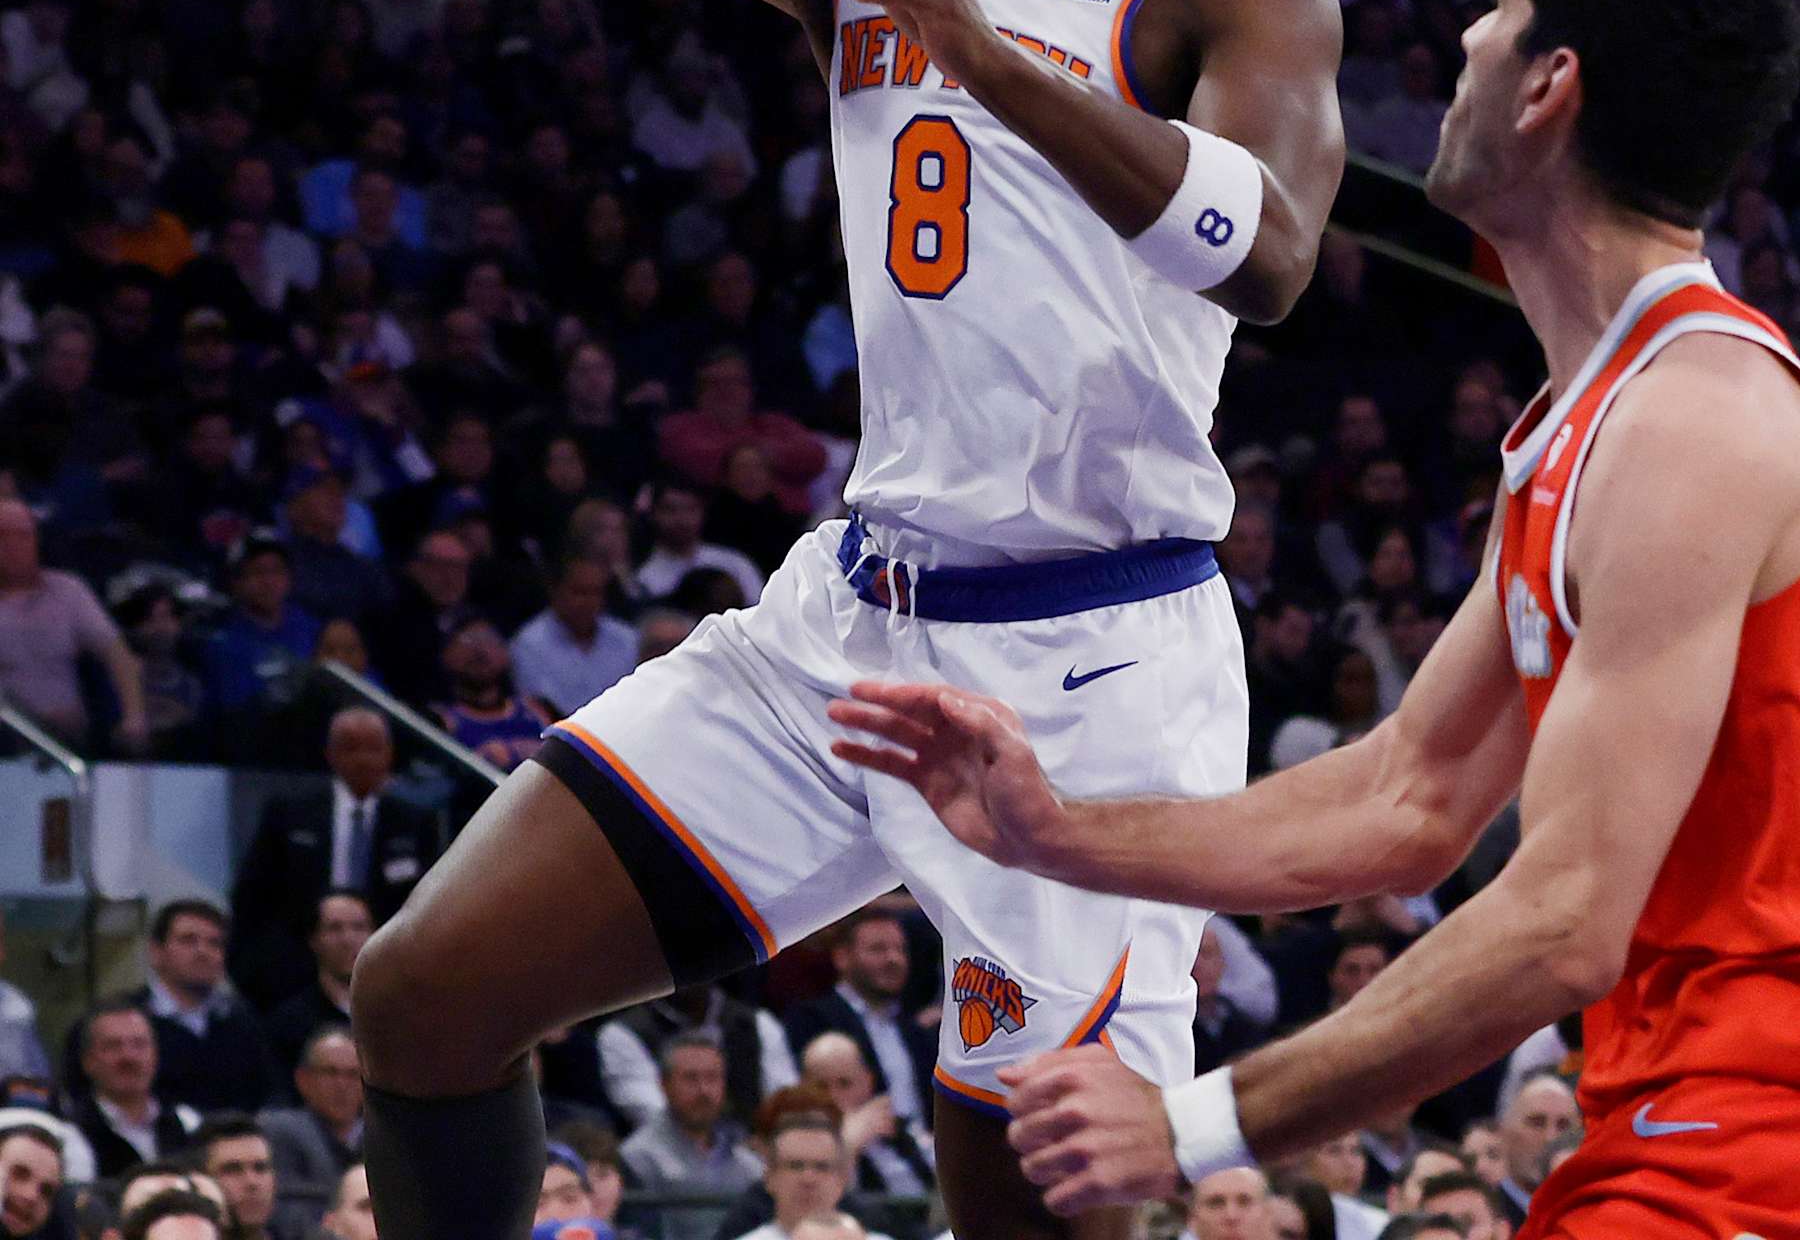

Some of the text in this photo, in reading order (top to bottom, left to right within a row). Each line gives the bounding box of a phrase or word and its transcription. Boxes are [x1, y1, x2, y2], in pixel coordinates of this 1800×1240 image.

[839, 15, 930, 98] NEW
[885, 114, 971, 301] 8
[1195, 207, 1234, 247] 8
[952, 957, 1026, 1029] KNICKS
